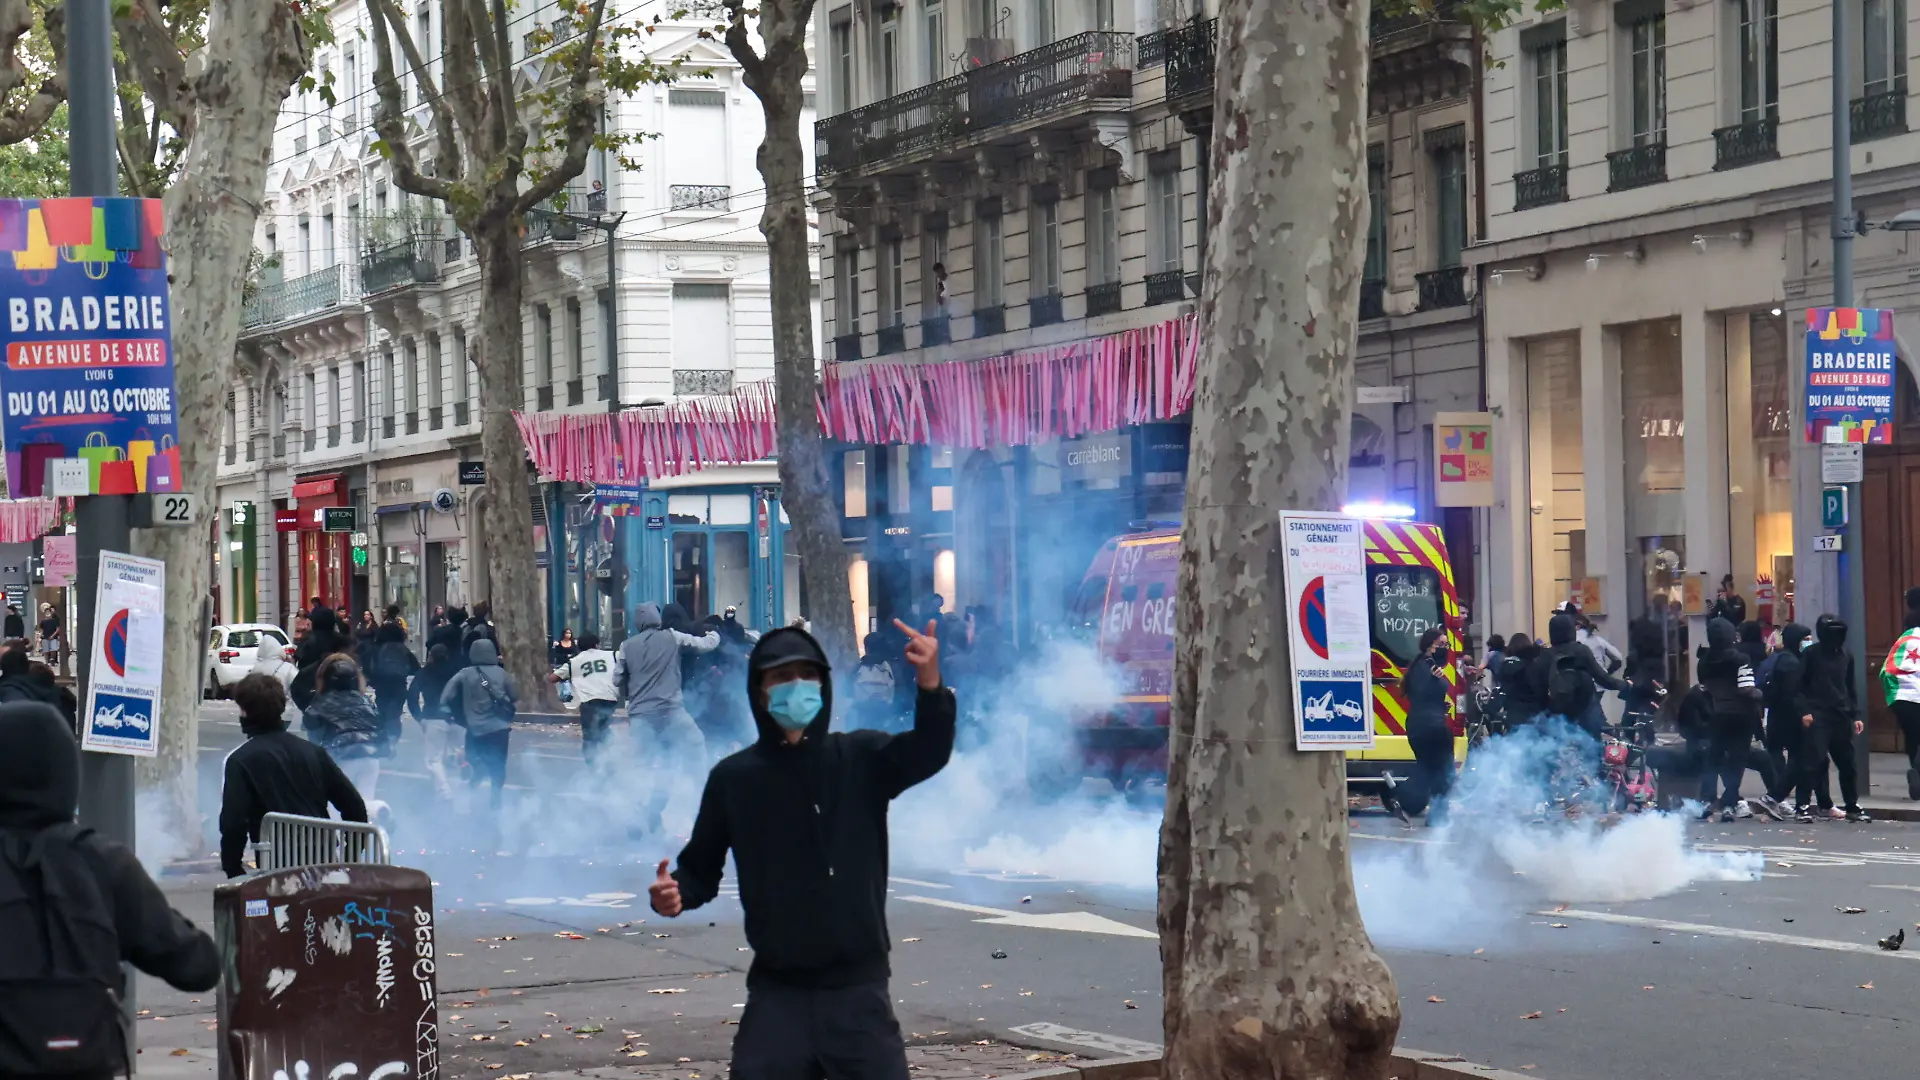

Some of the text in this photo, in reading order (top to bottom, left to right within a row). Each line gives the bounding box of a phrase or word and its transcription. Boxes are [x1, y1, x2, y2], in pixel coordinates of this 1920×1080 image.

[9, 295, 164, 333] BRADERIE
[18, 339, 160, 366] AVENUE DE SAXE
[1812, 352, 1891, 369] BRADERIE
[84, 369, 114, 381] LYON 6
[1815, 374, 1887, 384] AVENUE DE SAXE
[8, 387, 171, 416] DU 01 AU 03 OCTOBRE
[1809, 395, 1891, 407] DU 01 AU 03 OCTOBRE
[1067, 443, 1121, 466] carréblanc
[165, 497, 189, 522] 22
[1827, 496, 1838, 520] P
[1289, 522, 1352, 533] STATIONNEMENT
[1306, 533, 1338, 543] GÊNANT
[1820, 538, 1835, 549] 17
[1290, 548, 1300, 557] DU
[107, 561, 157, 576] STATIONNEMENT
[119, 572, 145, 583] GÊNANT
[104, 582, 113, 590] DU
[1110, 596, 1177, 636] EN GRE
[580, 659, 607, 678] 36
[1297, 668, 1365, 678] FOURRIÈRE IMMÉDIATE
[94, 682, 155, 697] FOURRIÈRE IMMÉDIATE
